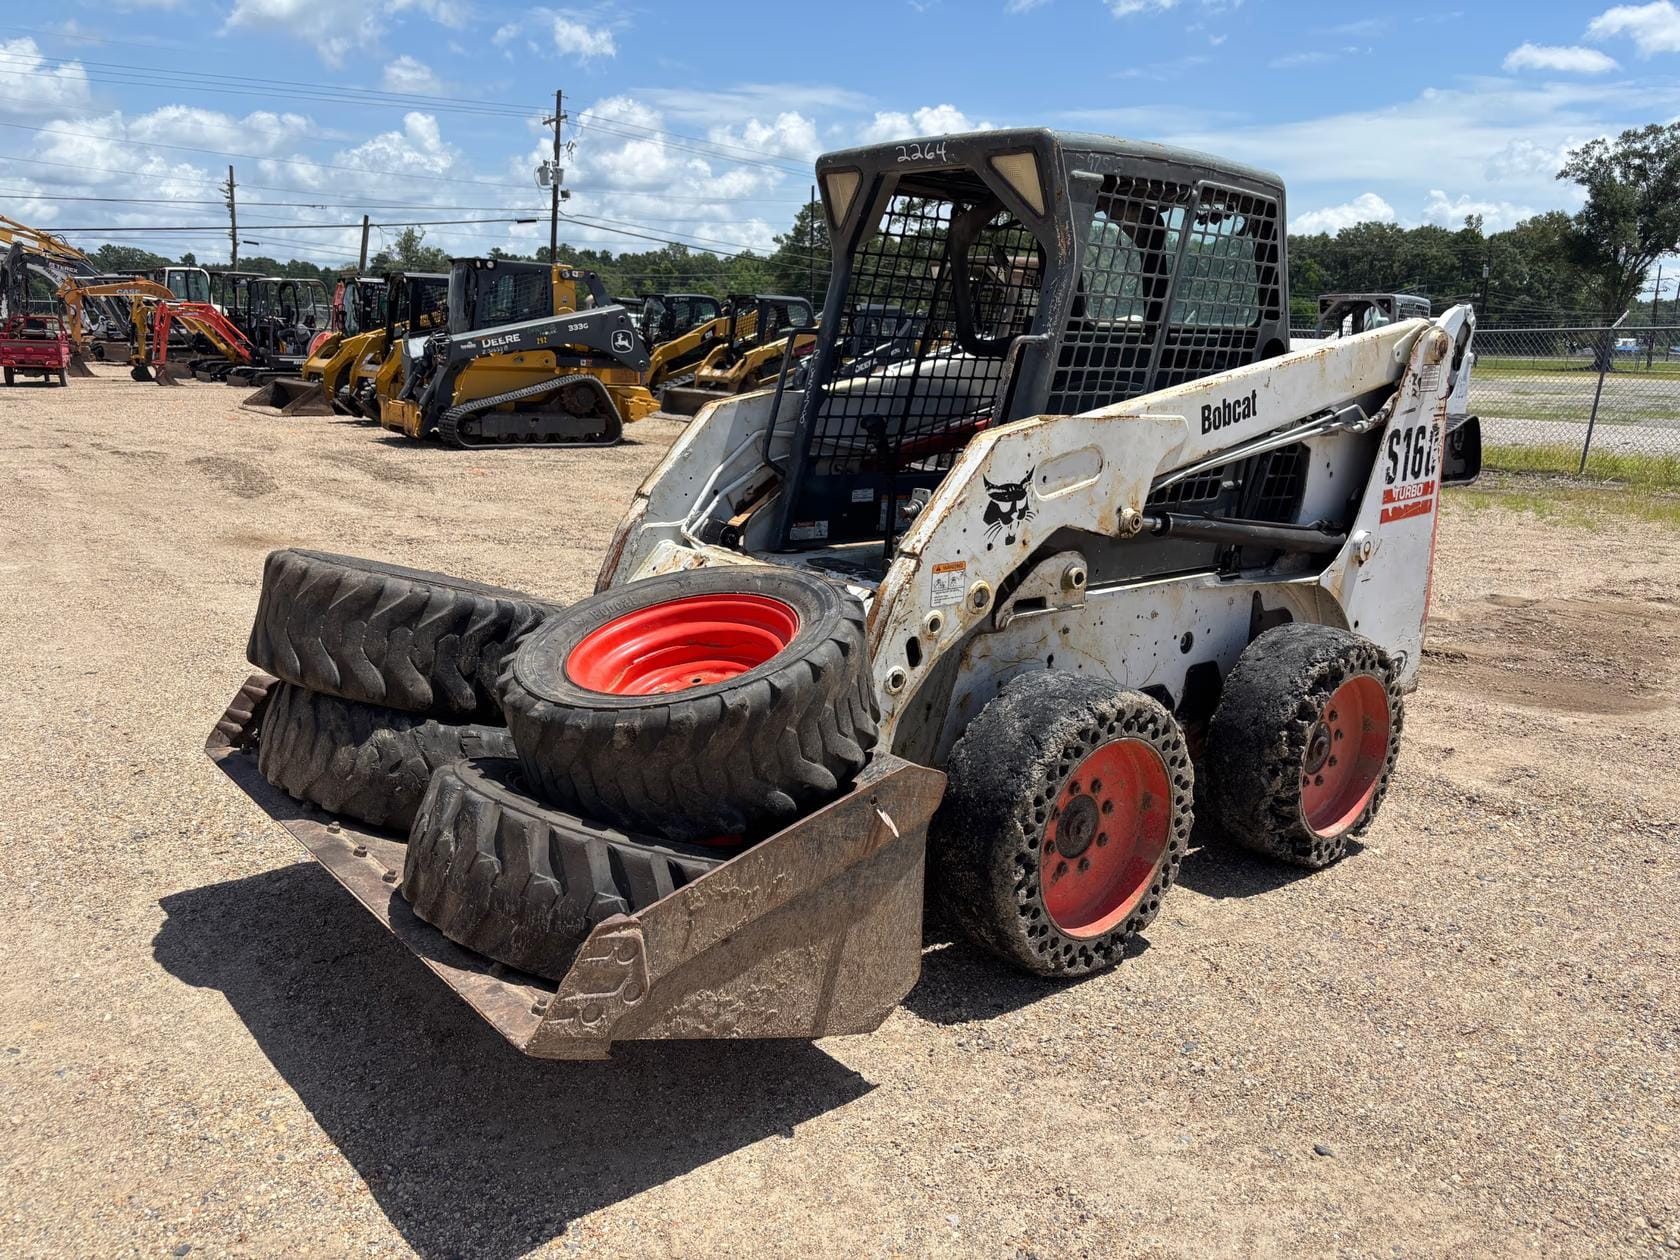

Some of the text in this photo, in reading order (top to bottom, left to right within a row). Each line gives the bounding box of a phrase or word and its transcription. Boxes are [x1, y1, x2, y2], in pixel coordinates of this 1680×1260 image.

[895, 141, 947, 163] 2264
[567, 322, 589, 332] 333G
[481, 333, 521, 349] DEERE
[1201, 389, 1257, 435] Bobcat
[1393, 483, 1424, 501] TURBO
